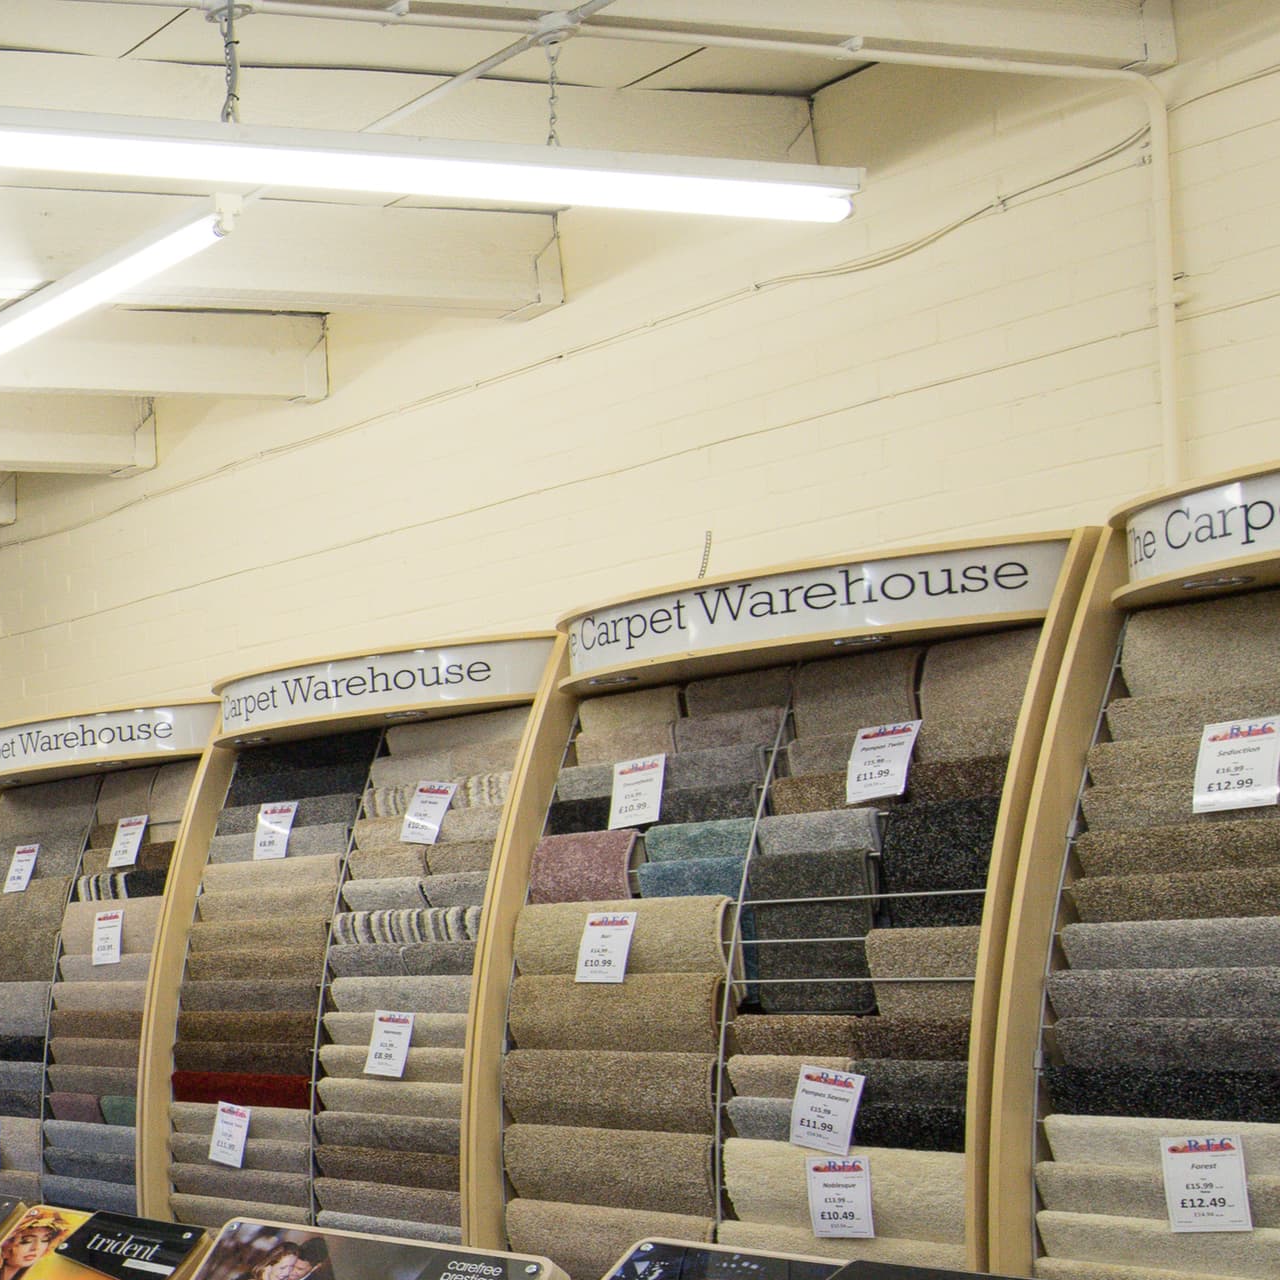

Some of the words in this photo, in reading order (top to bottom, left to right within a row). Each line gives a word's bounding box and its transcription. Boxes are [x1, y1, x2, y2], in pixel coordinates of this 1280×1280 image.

[1164, 499, 1280, 550] Carp
[580, 597, 688, 653] Carpet
[694, 560, 1031, 626] Warehouse
[224, 685, 278, 722] Carpet
[281, 660, 492, 705] Warehouse
[18, 721, 173, 755] Warehouse
[1217, 746, 1261, 757] Seduction
[856, 769, 890, 782] £11.99
[1207, 778, 1254, 792] £12.99
[619, 802, 647, 814] £10.99
[584, 959, 613, 968] £10.99
[800, 1118, 833, 1132] £11.99
[1185, 1182, 1214, 1190] £15.99
[1180, 1197, 1227, 1209] £12.49
[820, 1211, 855, 1221] £10.49
[86, 1232, 161, 1262] trident
[447, 1260, 503, 1277] carefree
